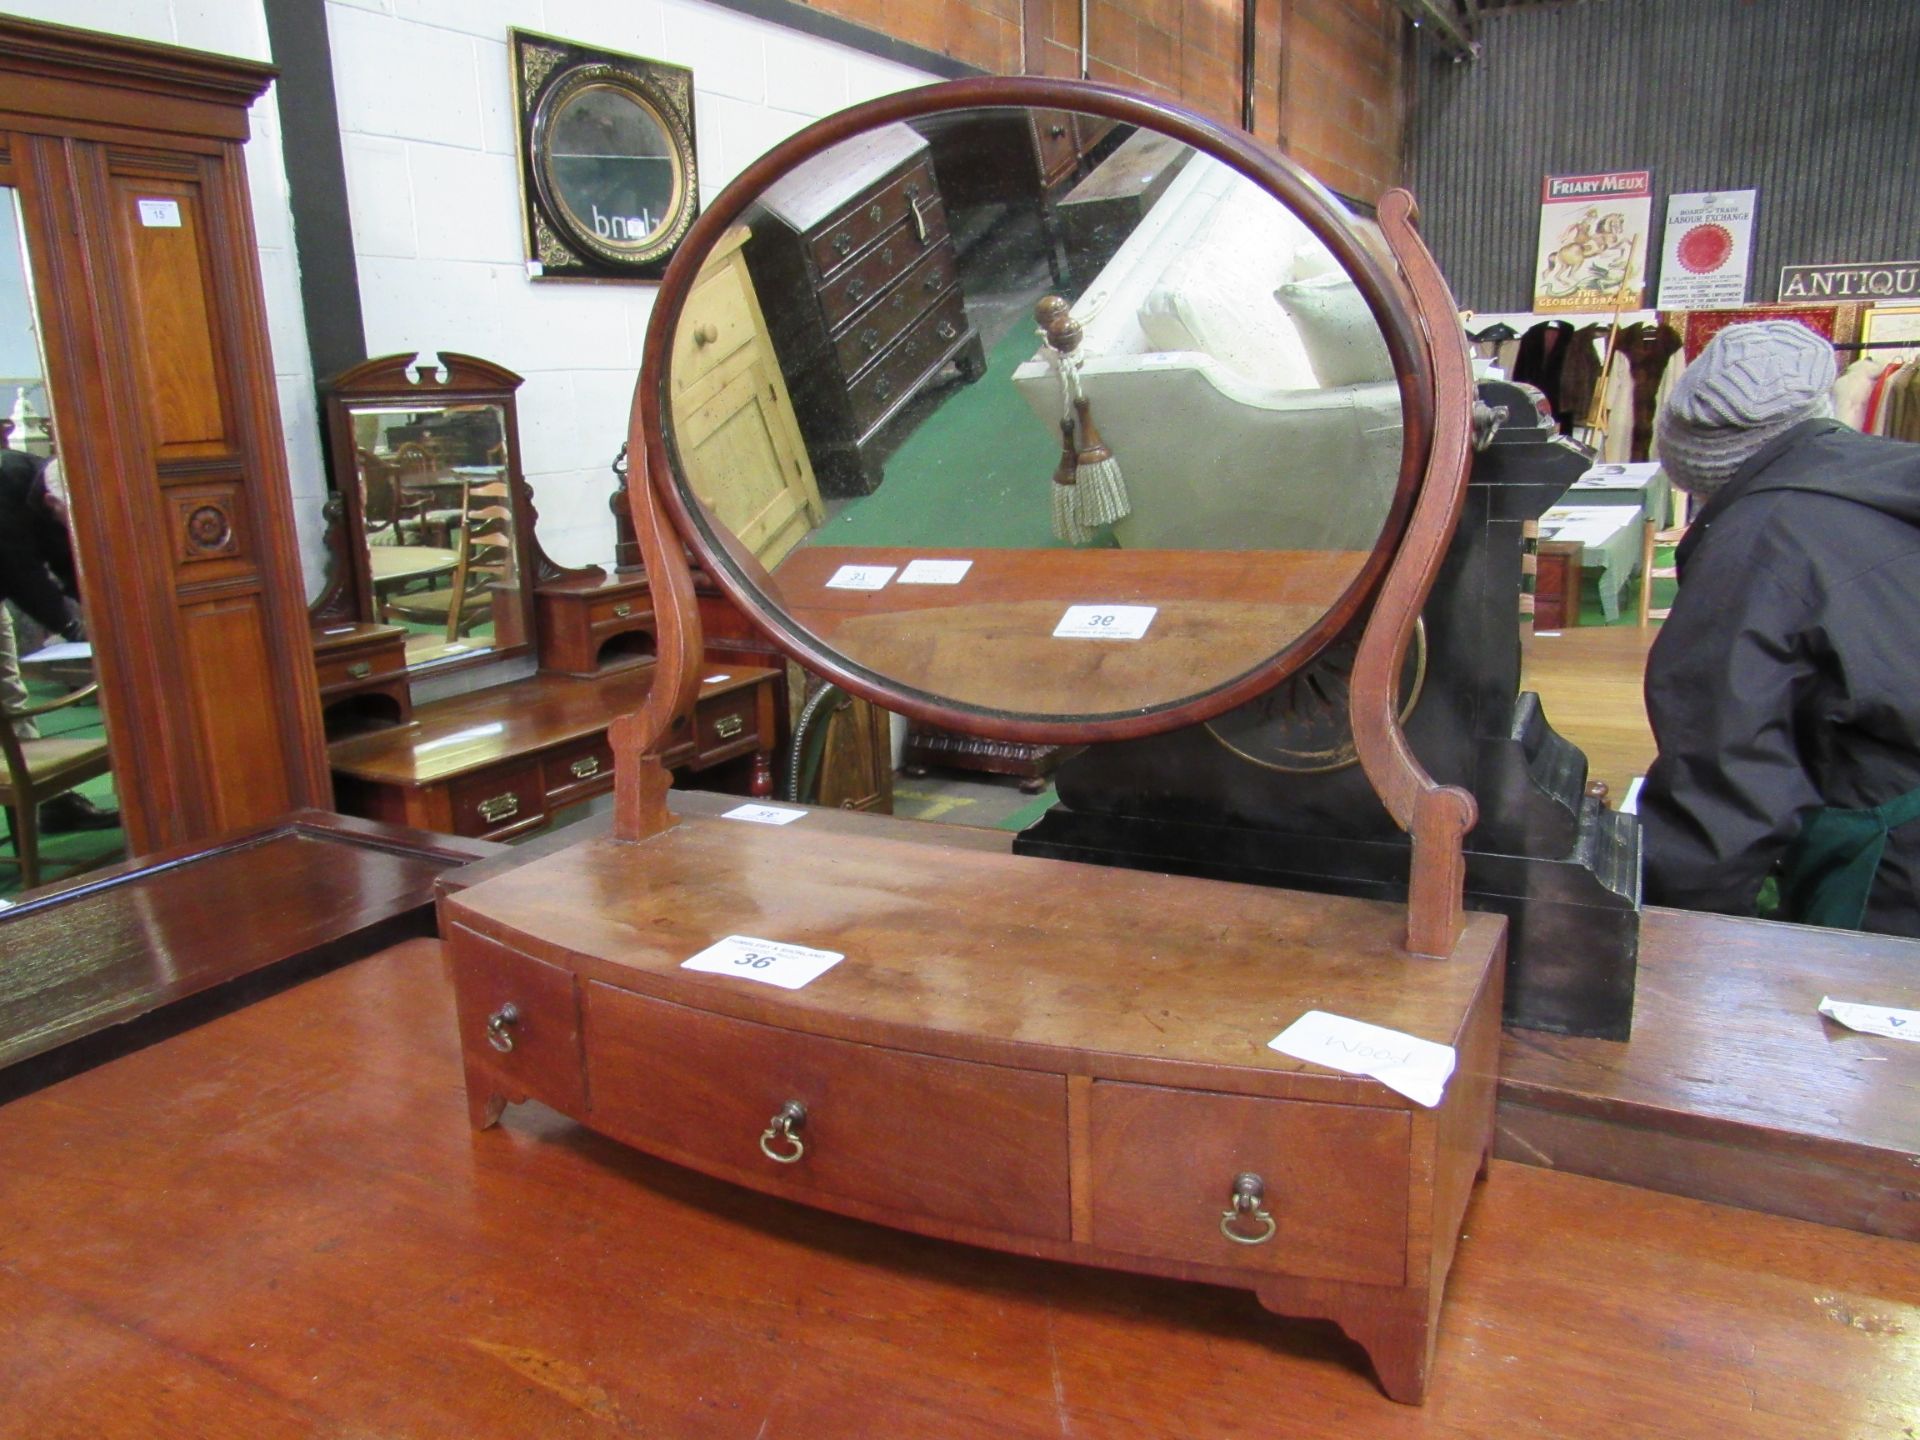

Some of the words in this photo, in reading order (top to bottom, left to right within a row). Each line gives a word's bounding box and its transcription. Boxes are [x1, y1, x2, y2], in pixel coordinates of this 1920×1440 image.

[1552, 180, 1600, 195] FRIARY
[1601, 176, 1645, 191] MEUX
[1668, 216, 1703, 224] LABOUR
[1705, 213, 1750, 222] EXCHANGE
[1783, 268, 1920, 296] ANTIQU
[1539, 297, 1580, 306] GEORGE
[734, 953, 777, 968] 36
